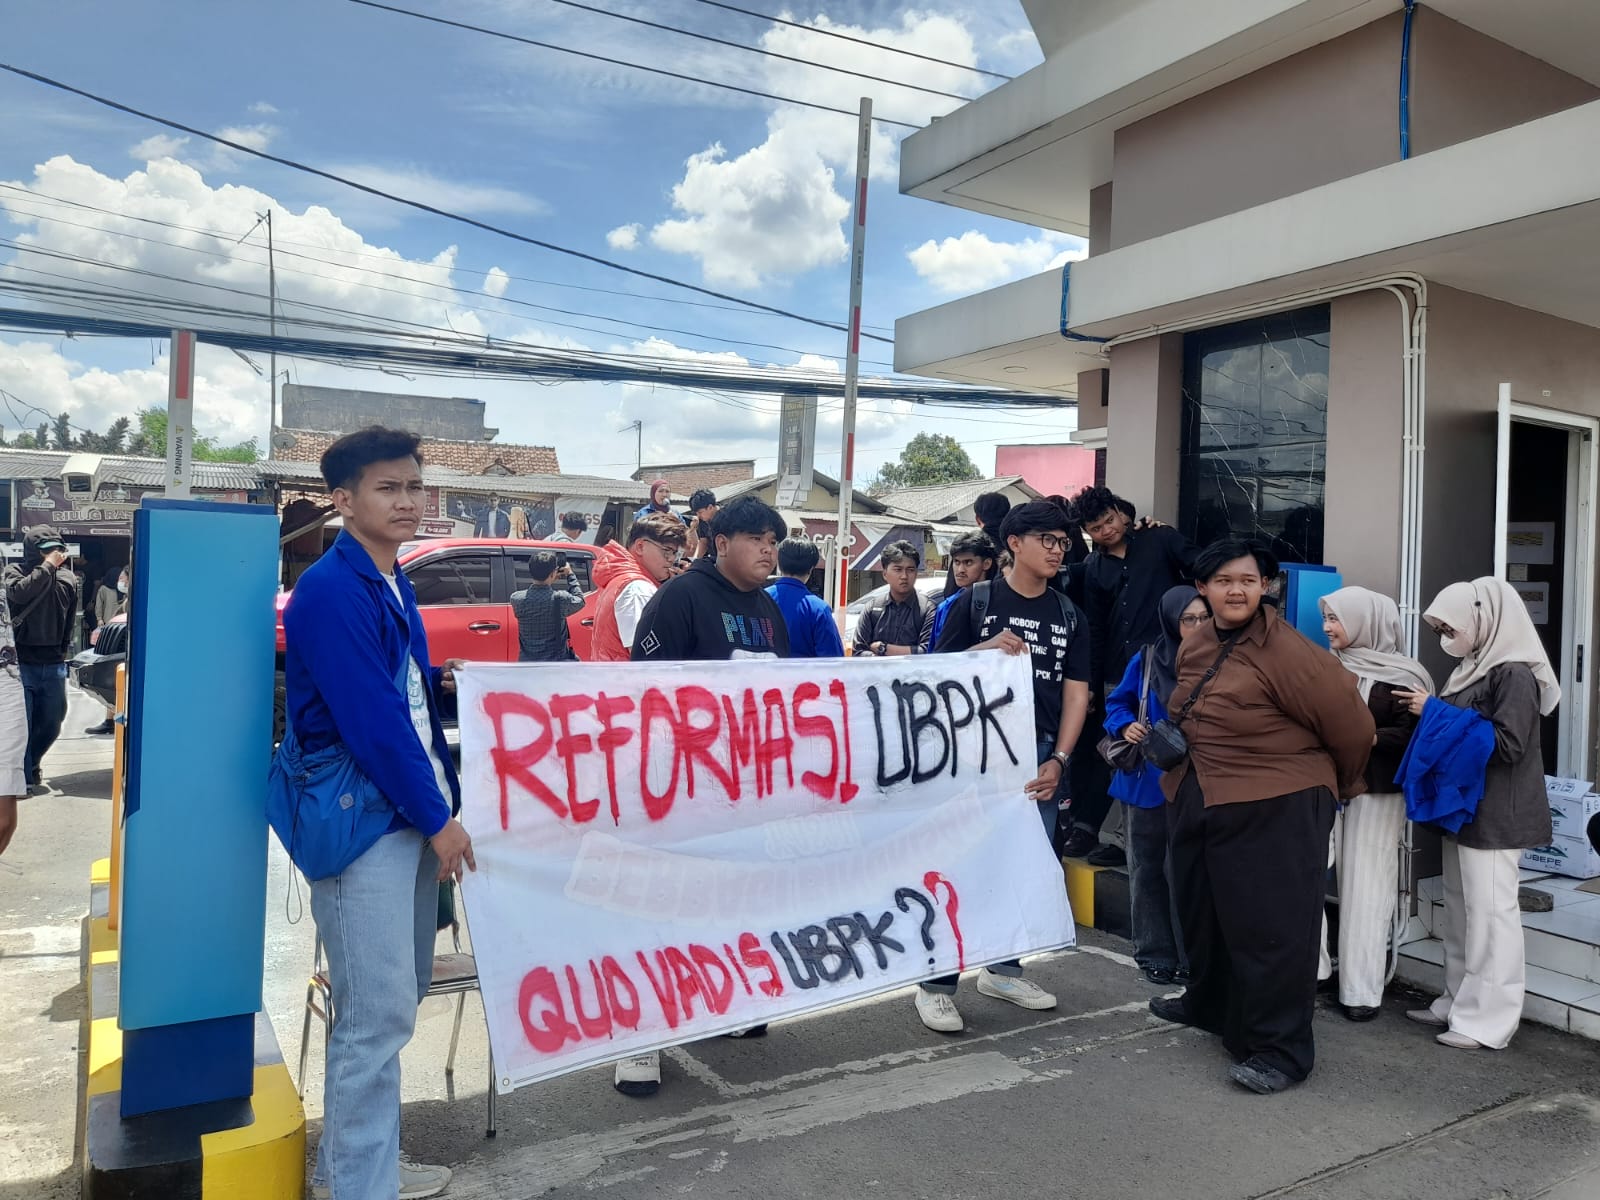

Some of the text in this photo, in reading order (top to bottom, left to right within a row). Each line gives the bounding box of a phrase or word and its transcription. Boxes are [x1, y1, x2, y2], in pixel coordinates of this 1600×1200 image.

[174, 436, 183, 475] WARNING
[1009, 617, 1041, 630] NOBODY
[1023, 631, 1039, 642] THA
[1031, 644, 1048, 656] THIS
[483, 678, 860, 831] REFORMASI
[866, 675, 1019, 788] UBPK
[518, 955, 641, 1053] QUO
